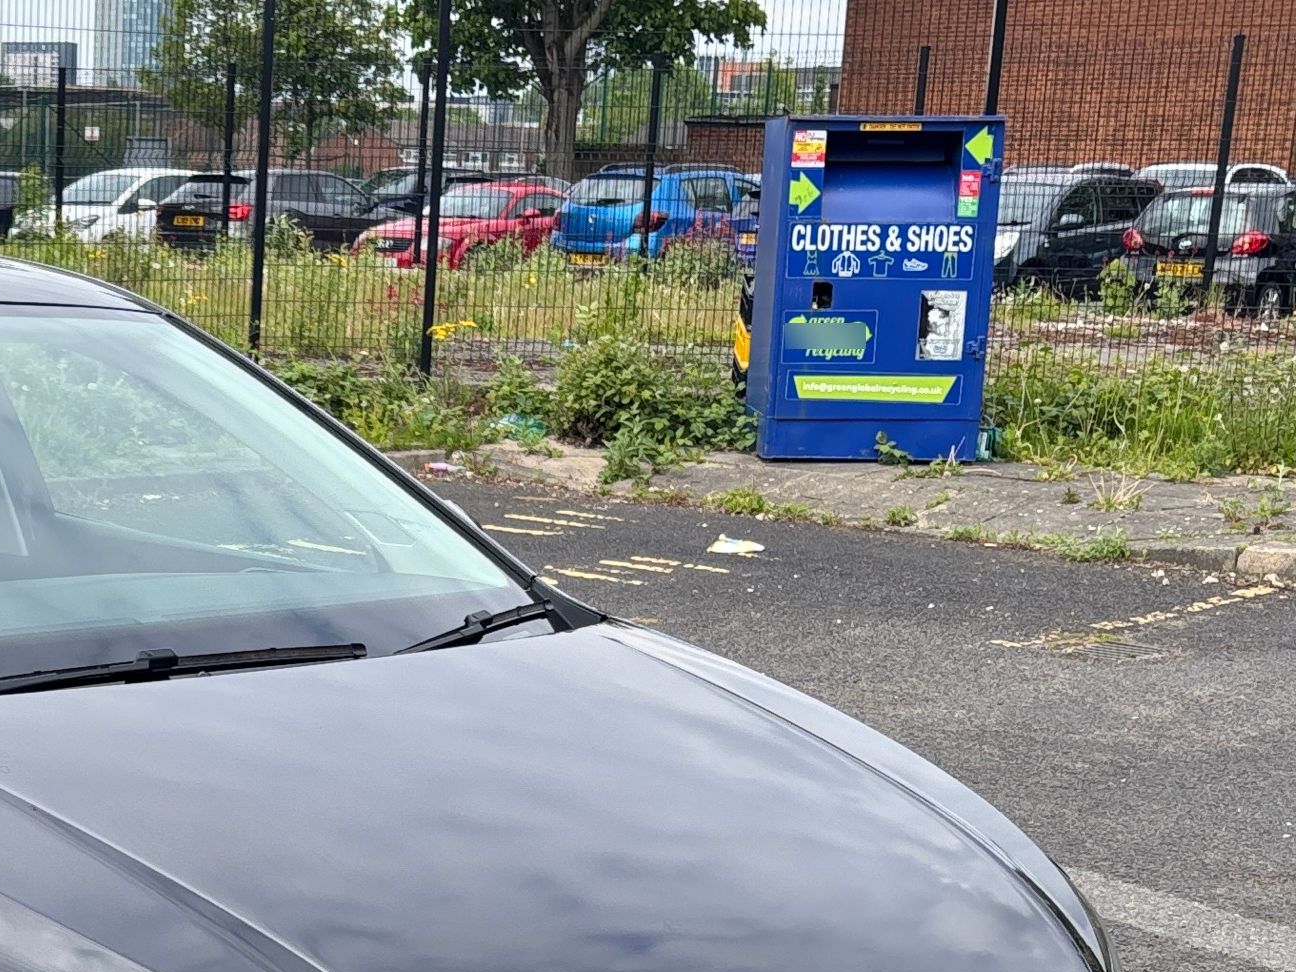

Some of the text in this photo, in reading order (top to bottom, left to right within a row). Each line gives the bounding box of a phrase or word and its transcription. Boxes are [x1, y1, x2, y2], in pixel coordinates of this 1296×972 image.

[791, 224, 881, 252] CLOTHES
[885, 225, 902, 252] &
[906, 225, 973, 253] SHOES
